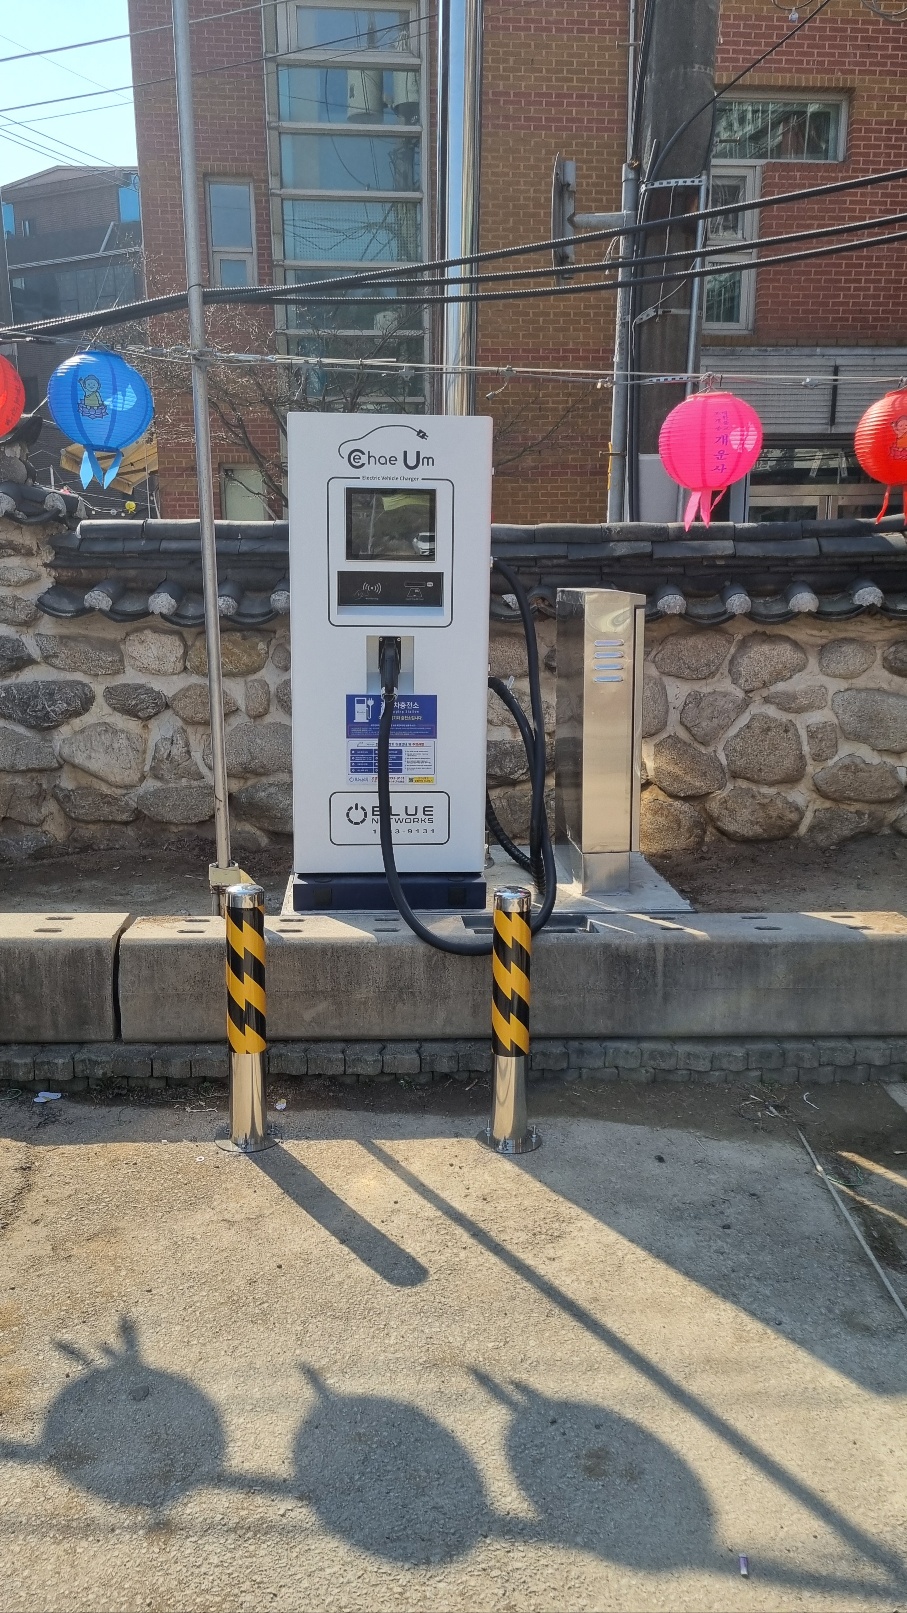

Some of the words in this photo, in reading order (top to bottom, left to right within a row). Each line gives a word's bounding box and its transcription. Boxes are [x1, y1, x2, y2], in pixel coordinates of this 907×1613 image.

[403, 450, 435, 470] Um
[711, 434, 729, 473] 개운사
[372, 805, 434, 816] BLUE
